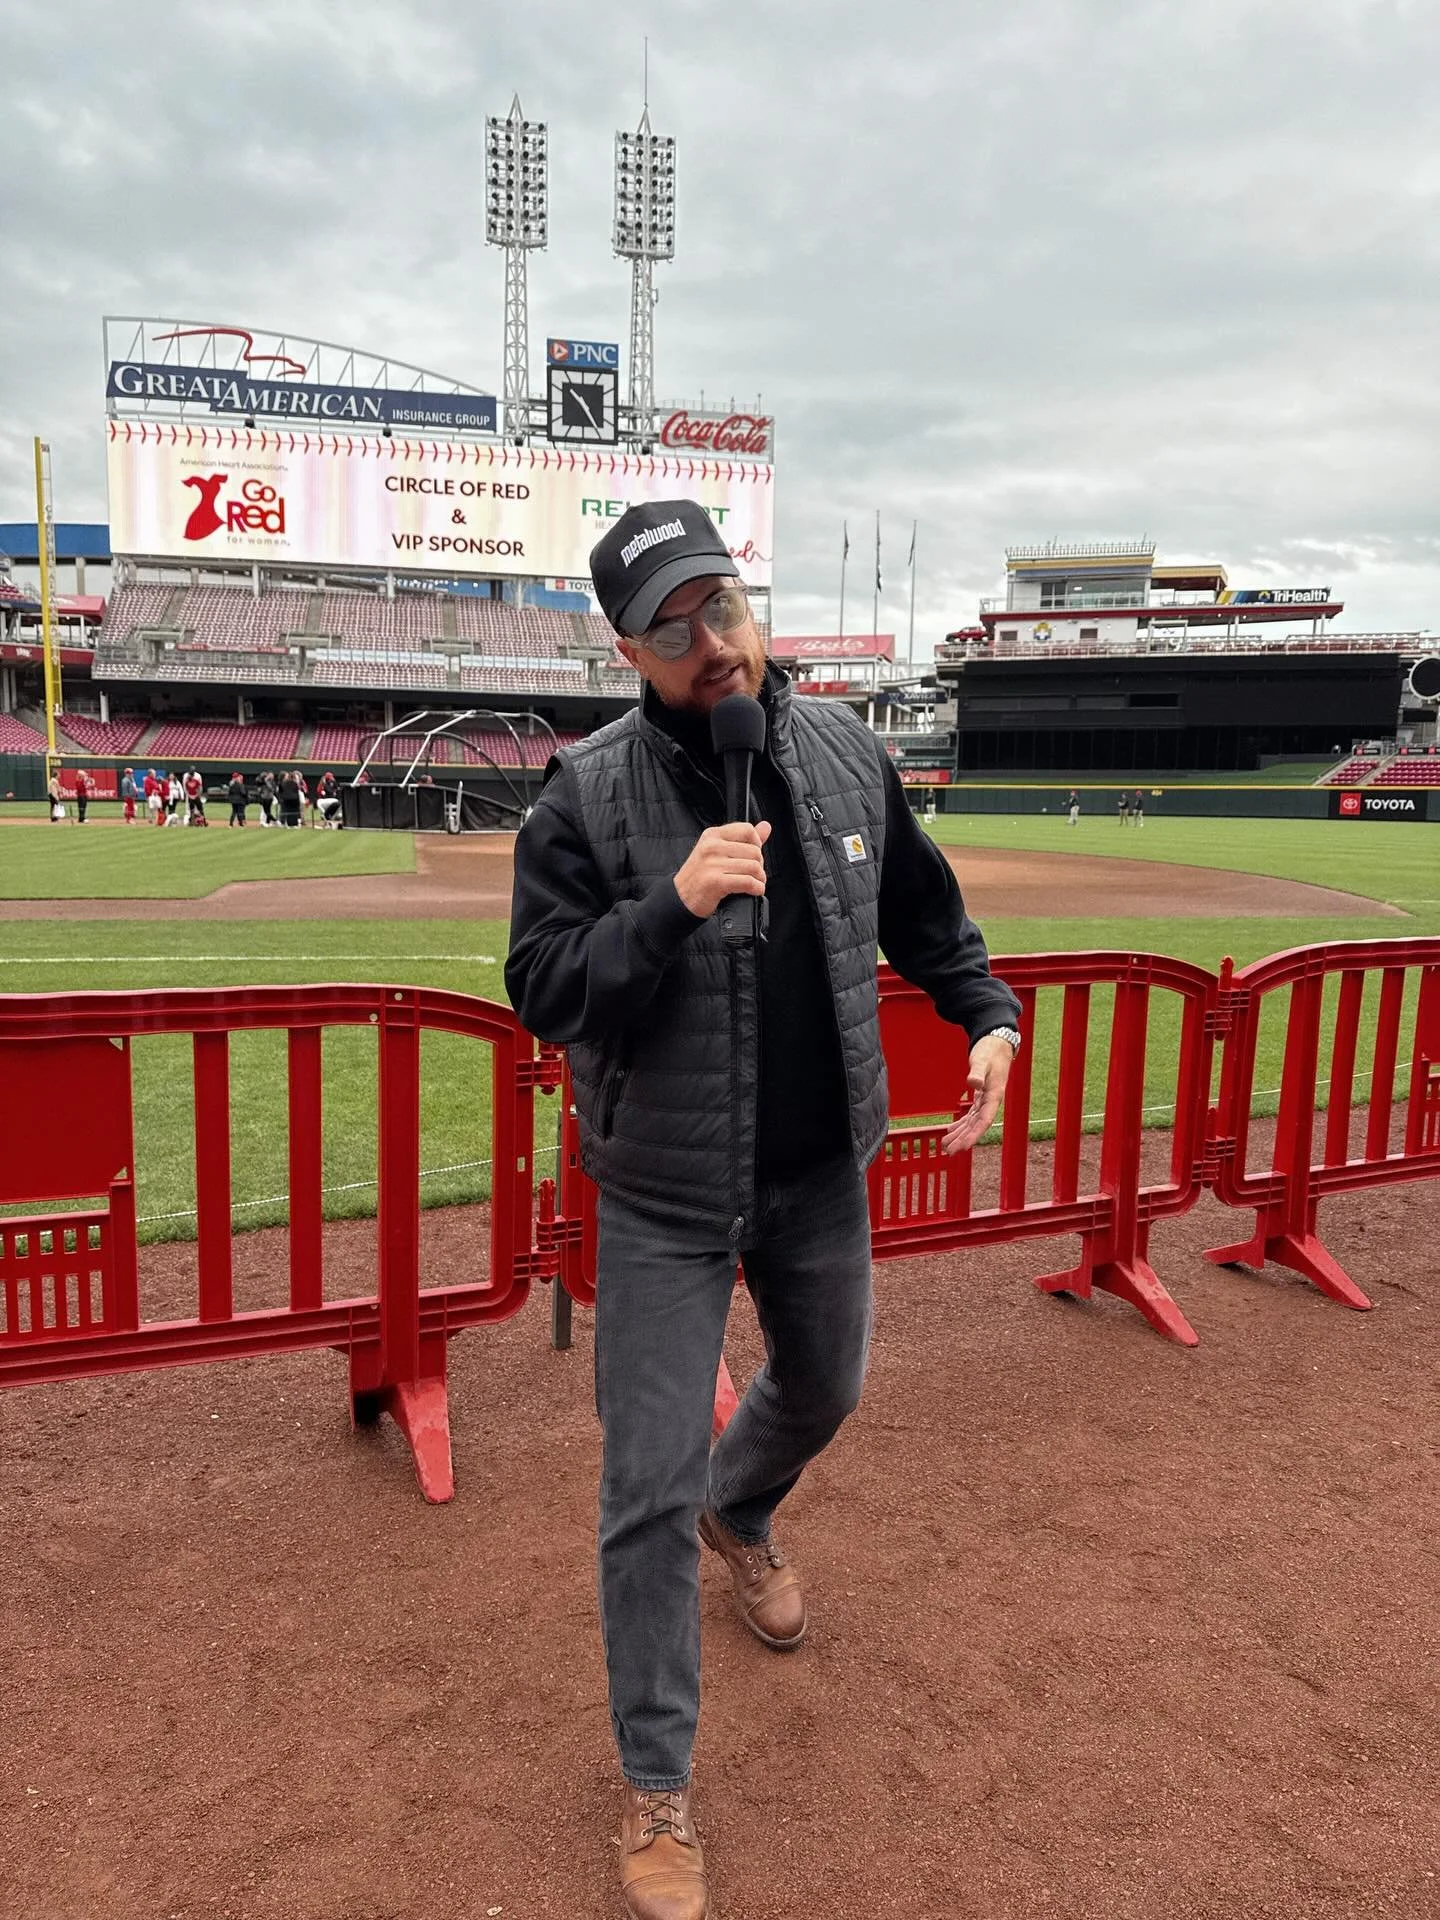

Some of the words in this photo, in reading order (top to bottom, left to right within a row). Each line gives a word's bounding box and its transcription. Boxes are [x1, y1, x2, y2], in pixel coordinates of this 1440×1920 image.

[572, 343, 617, 365] PNC
[113, 365, 228, 401] GREAT
[216, 380, 383, 421] AMERICAN
[392, 409, 452, 425] INSURANCE
[455, 414, 491, 426] GROUP
[659, 409, 773, 455] Coca-Cola
[180, 458, 217, 467] American
[218, 461, 240, 469] Heart
[242, 479, 277, 503] Go
[384, 475, 455, 496] CIRCLE
[459, 480, 487, 497] OF
[492, 483, 530, 500] RED
[226, 497, 286, 534] Red
[451, 508, 467, 525] &
[227, 535, 243, 544] for
[392, 533, 424, 551] VIP
[428, 535, 525, 557] SPONSOR
[620, 518, 687, 568] metalwood
[1271, 589, 1328, 602] TriHealth
[1364, 798, 1416, 811] TOYOTA
